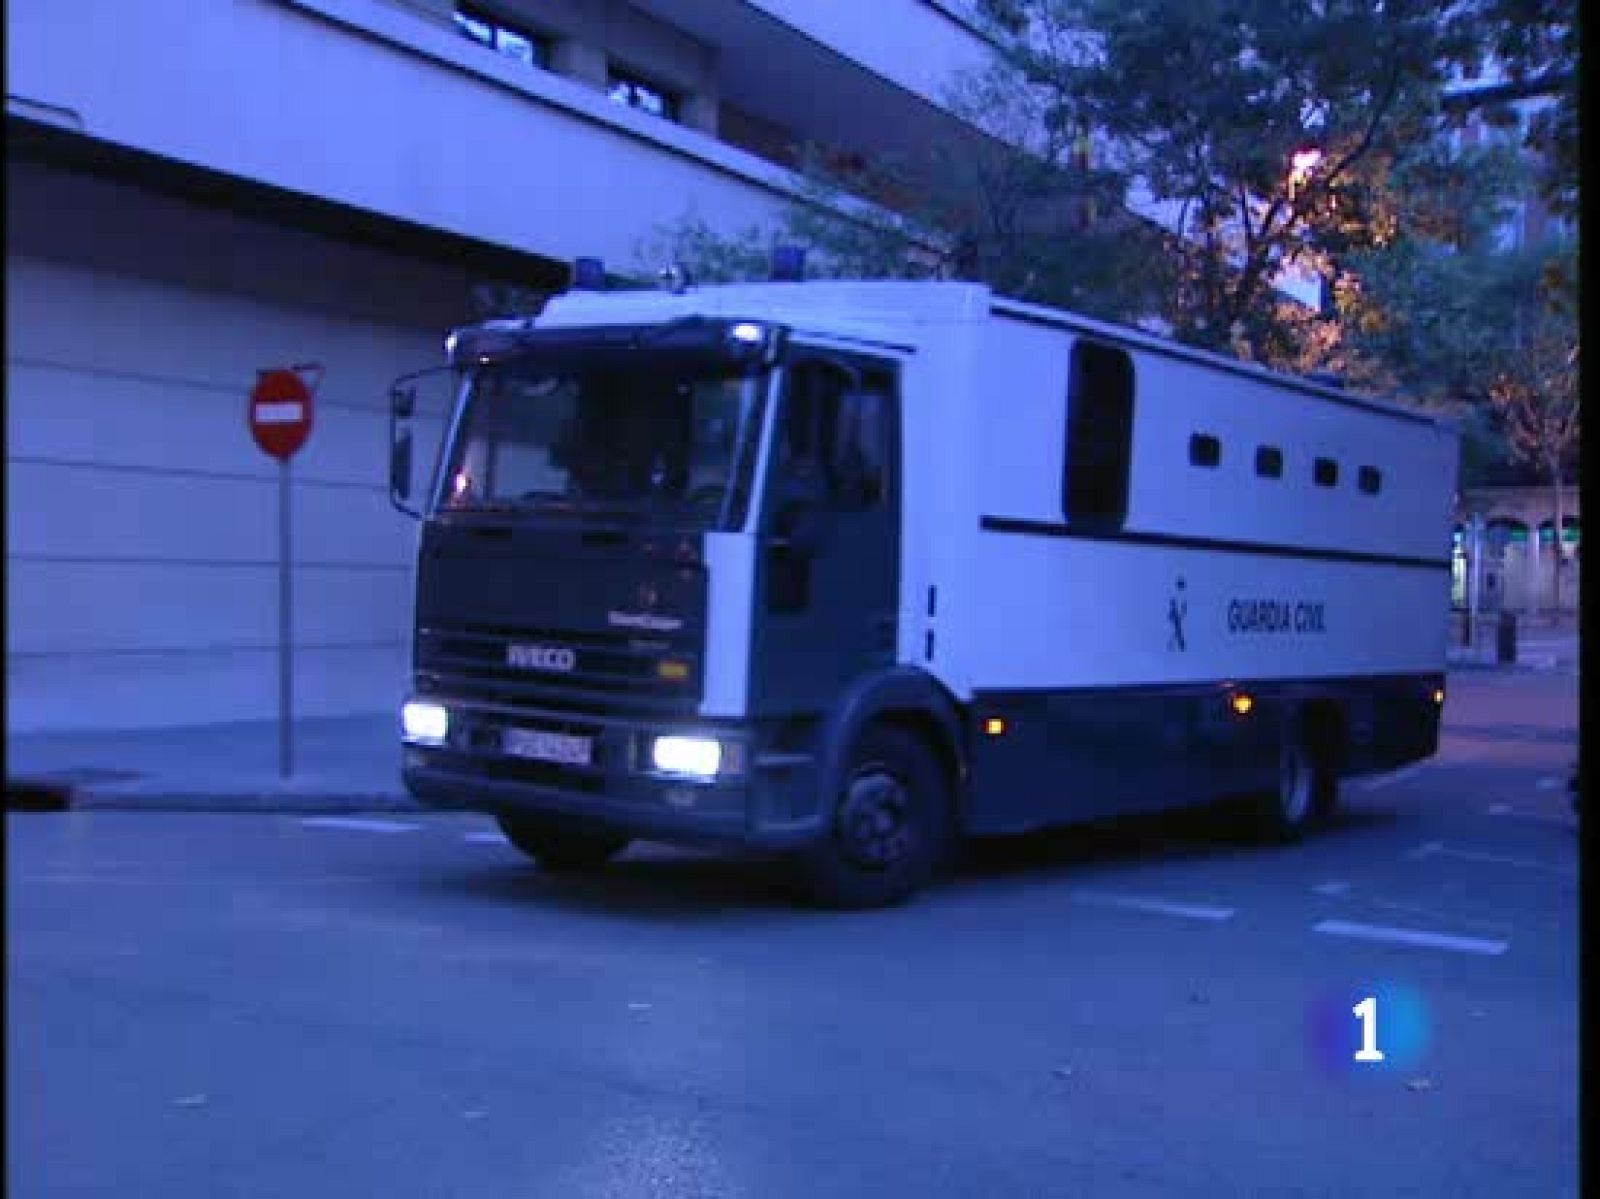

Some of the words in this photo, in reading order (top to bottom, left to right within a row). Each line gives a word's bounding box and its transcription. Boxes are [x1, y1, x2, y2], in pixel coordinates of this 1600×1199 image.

[1228, 599, 1289, 634] GUARDIA
[1294, 600, 1326, 634] CIVIL
[508, 645, 575, 671] IVECO
